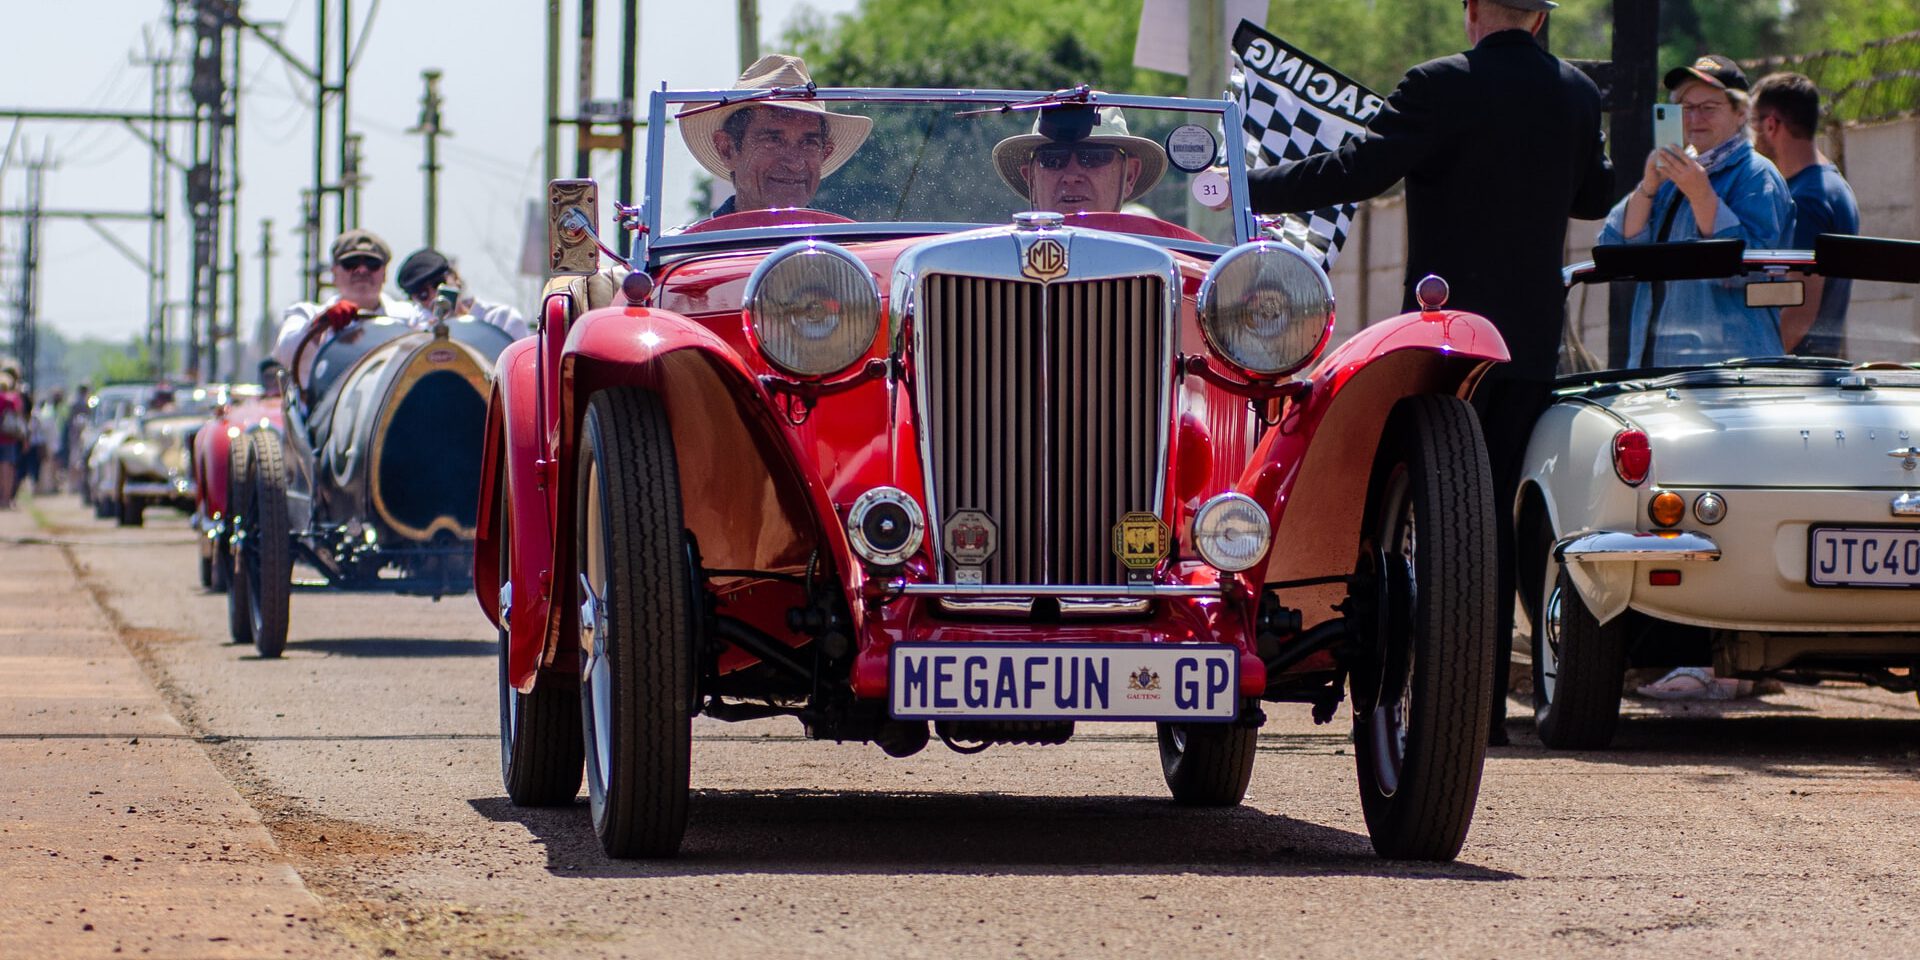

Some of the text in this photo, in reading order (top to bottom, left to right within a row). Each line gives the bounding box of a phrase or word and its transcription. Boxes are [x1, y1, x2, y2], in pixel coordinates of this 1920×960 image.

[1203, 184, 1218, 196] 31
[1033, 242, 1060, 269] MG
[1820, 538, 1919, 575] JTC40
[903, 655, 1229, 710] MEGAFUN GP
